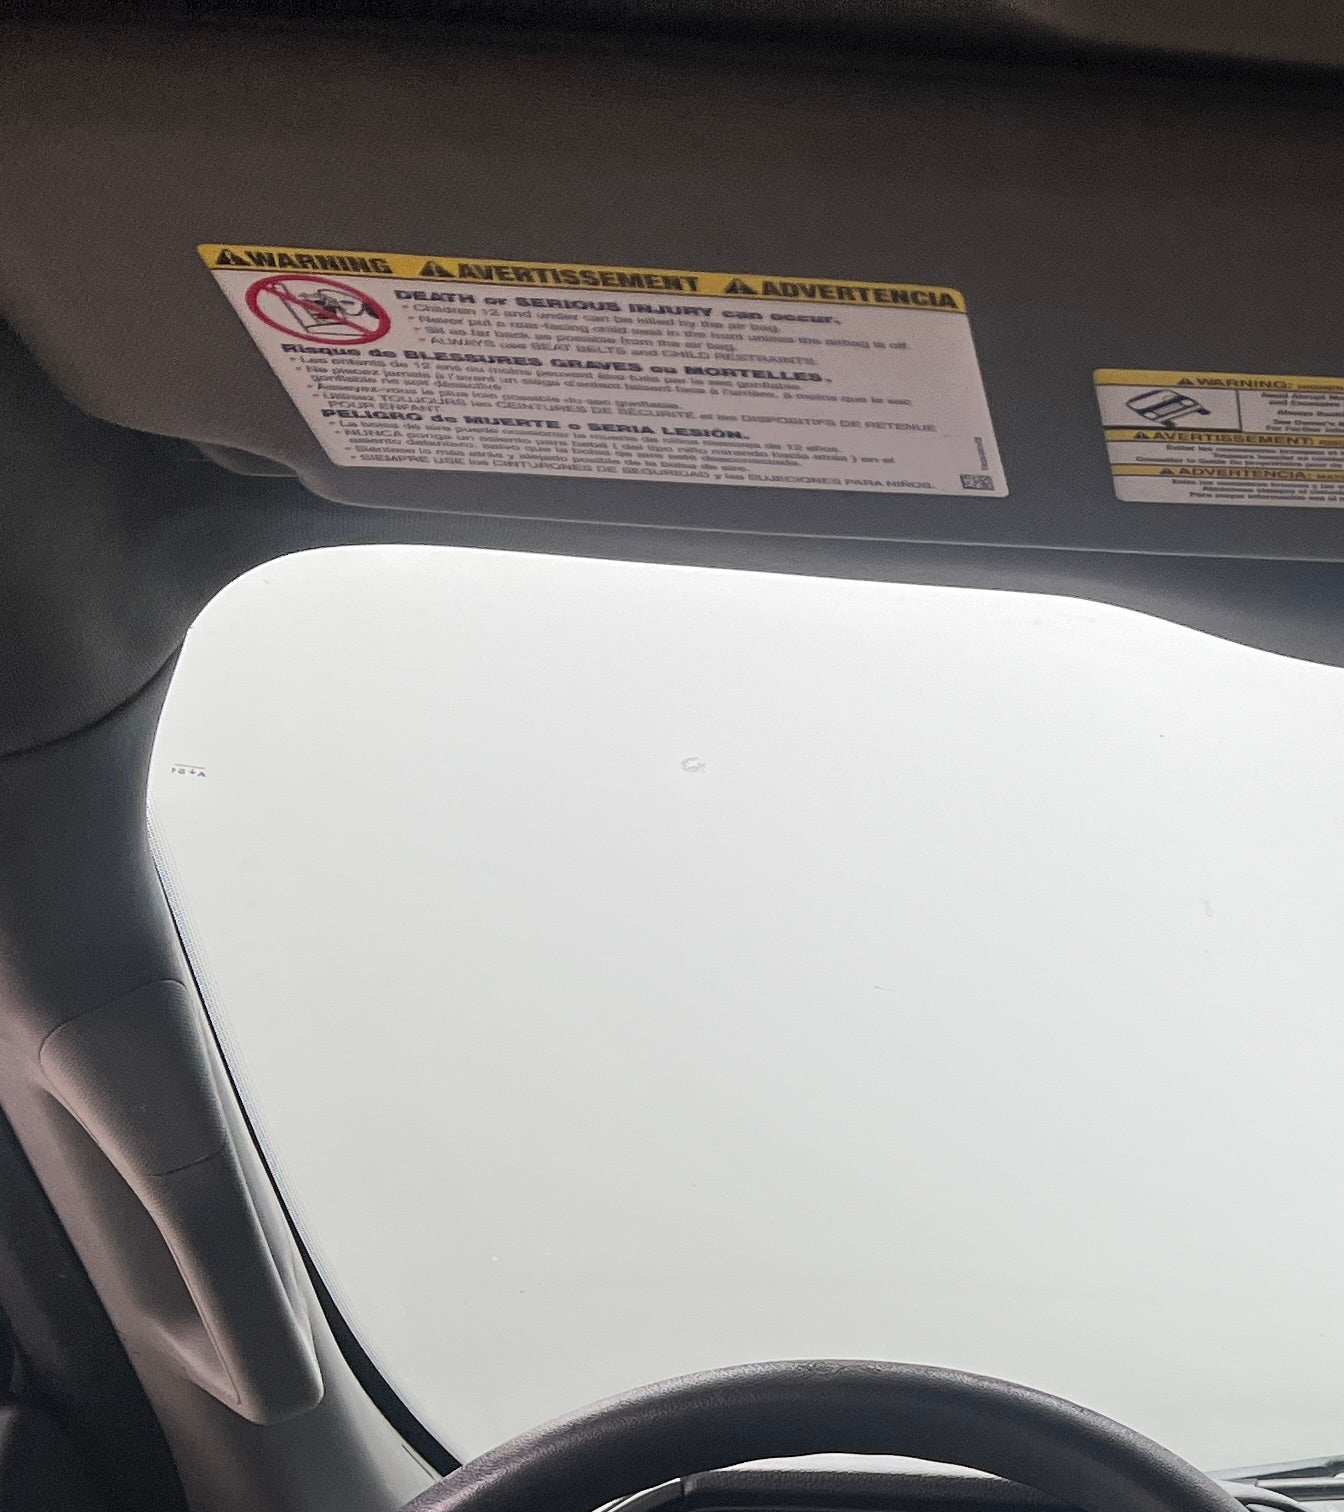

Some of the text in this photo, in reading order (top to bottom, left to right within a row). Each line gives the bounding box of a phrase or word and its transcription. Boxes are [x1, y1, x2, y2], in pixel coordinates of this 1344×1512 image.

[246, 251, 394, 274] WARNING
[456, 262, 698, 290] AVERTISSEMENT
[393, 290, 475, 304] DEATH
[483, 295, 507, 306] or
[514, 296, 620, 312] SERIOUS
[627, 302, 712, 317] INJURY
[721, 307, 763, 320] can
[759, 278, 958, 305] ADVERTENCIA
[280, 343, 361, 357] Risque
[367, 348, 397, 359] de
[403, 349, 543, 367] BLESSURES
[549, 357, 642, 372] GRAVES
[649, 363, 678, 374] ou
[320, 407, 423, 422] PELIGRO
[429, 413, 458, 424] de
[462, 415, 561, 430] MUERTE
[567, 420, 580, 431] o
[587, 421, 654, 435] SERIA
